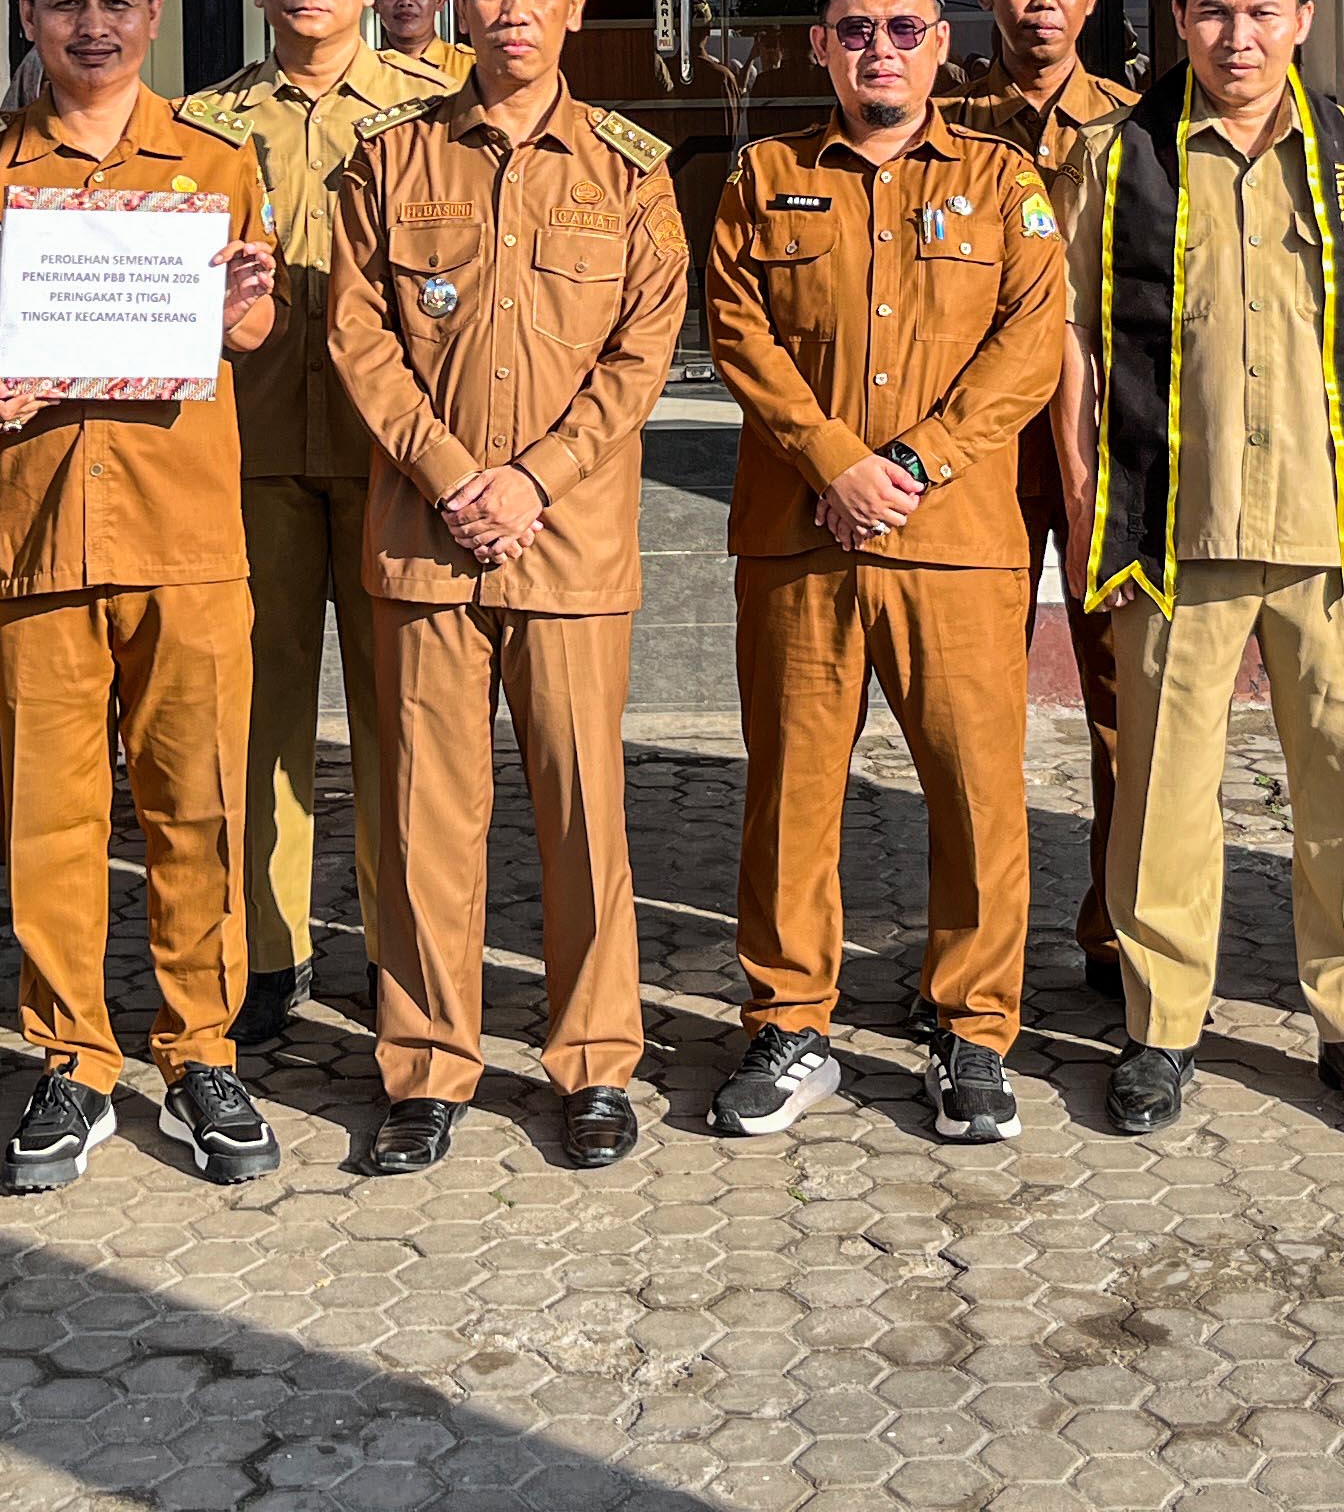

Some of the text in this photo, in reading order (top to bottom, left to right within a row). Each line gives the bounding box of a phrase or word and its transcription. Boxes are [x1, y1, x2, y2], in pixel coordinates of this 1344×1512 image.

[557, 211, 617, 230] CAMAT
[40, 254, 183, 266] PEROLEHAN SEMENTARA
[21, 272, 200, 284] PENERIMAAN PBB TAHUN 2026
[49, 292, 171, 304] PERINGAKAT 3 (TIGA)
[21, 311, 197, 323] TINGKAT KECAMATAN SERANG
